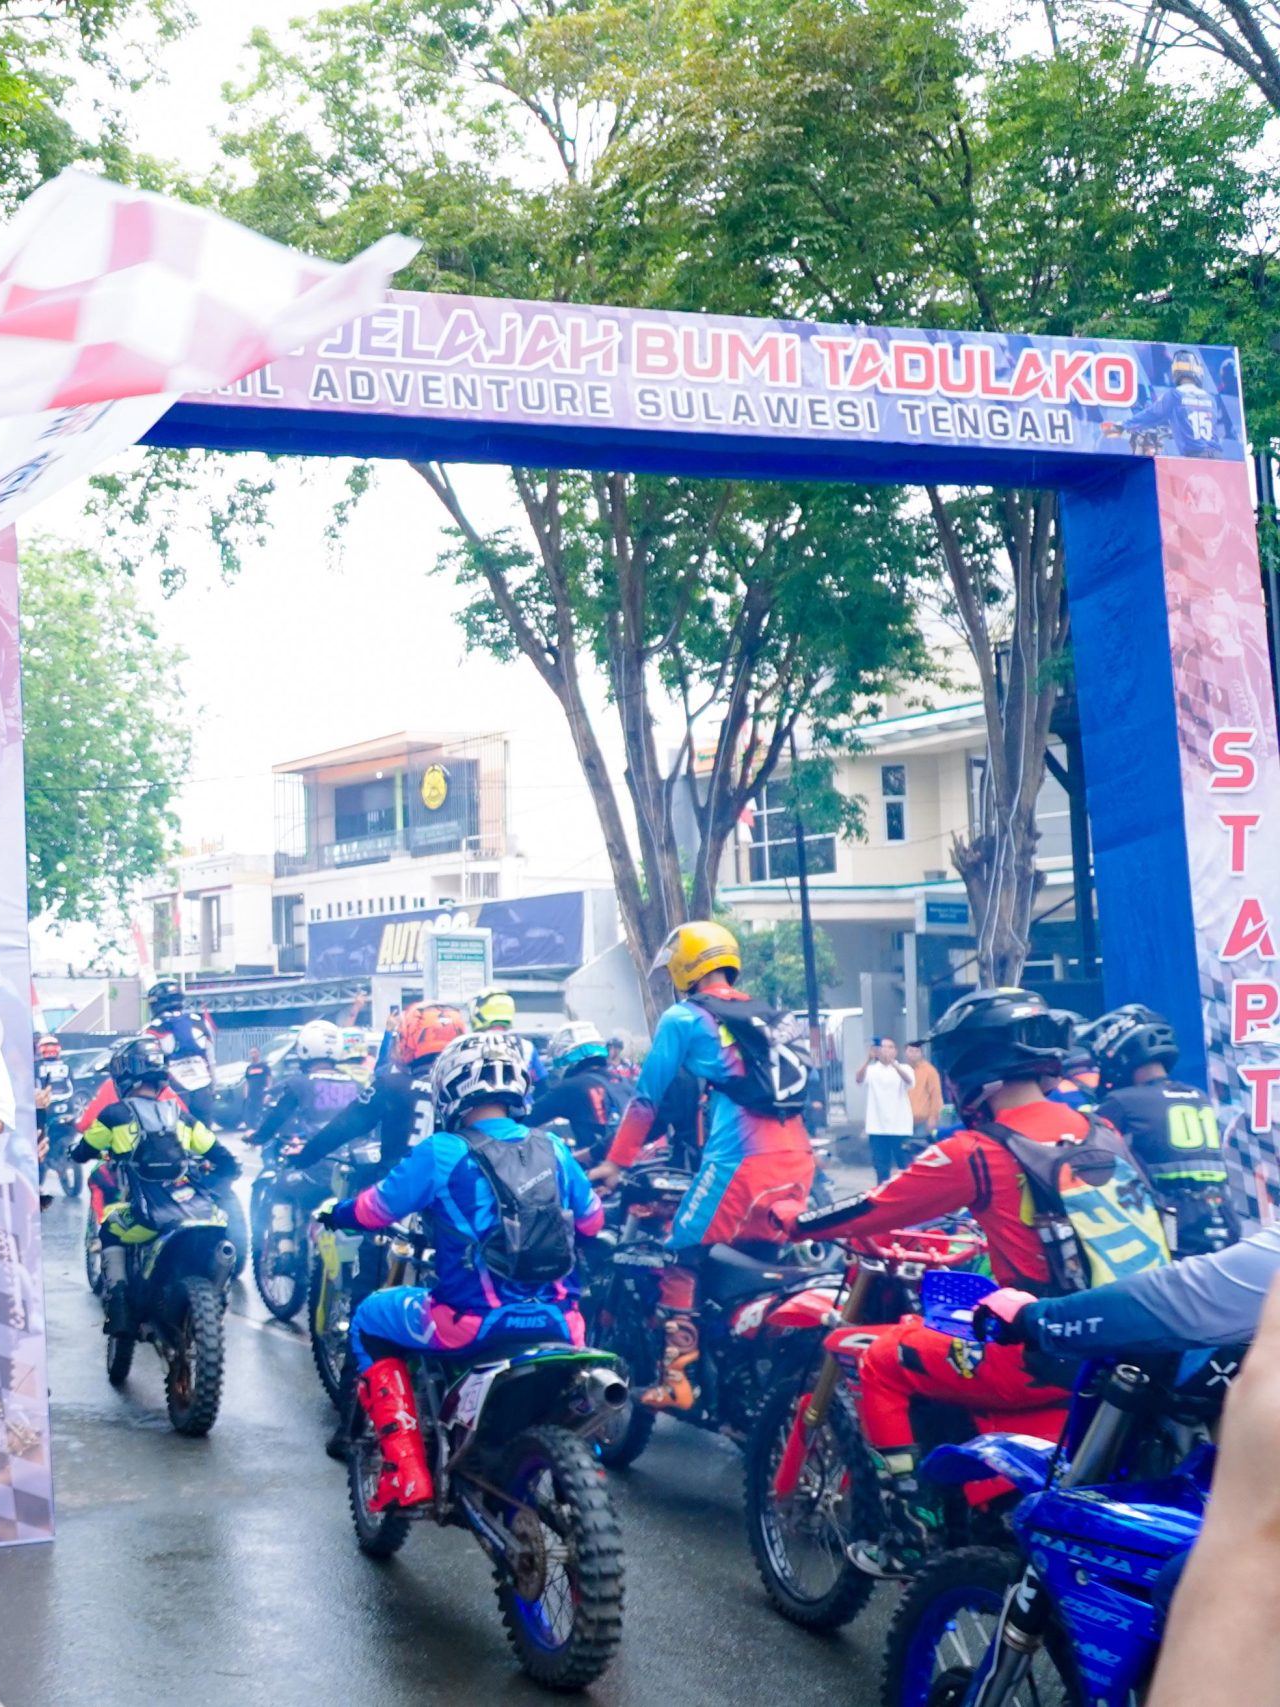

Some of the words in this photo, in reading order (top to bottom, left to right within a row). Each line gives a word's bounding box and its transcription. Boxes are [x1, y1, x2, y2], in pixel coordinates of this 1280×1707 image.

[322, 305, 618, 372] JELAJAH
[634, 328, 799, 384] BUMI
[816, 339, 1136, 406] TADULAKO
[312, 366, 613, 416] ADVENTURE
[639, 387, 878, 432] SULAWESI
[904, 404, 1074, 443] TENGAH
[1188, 409, 1213, 441] 15
[1168, 1104, 1220, 1149] 01
